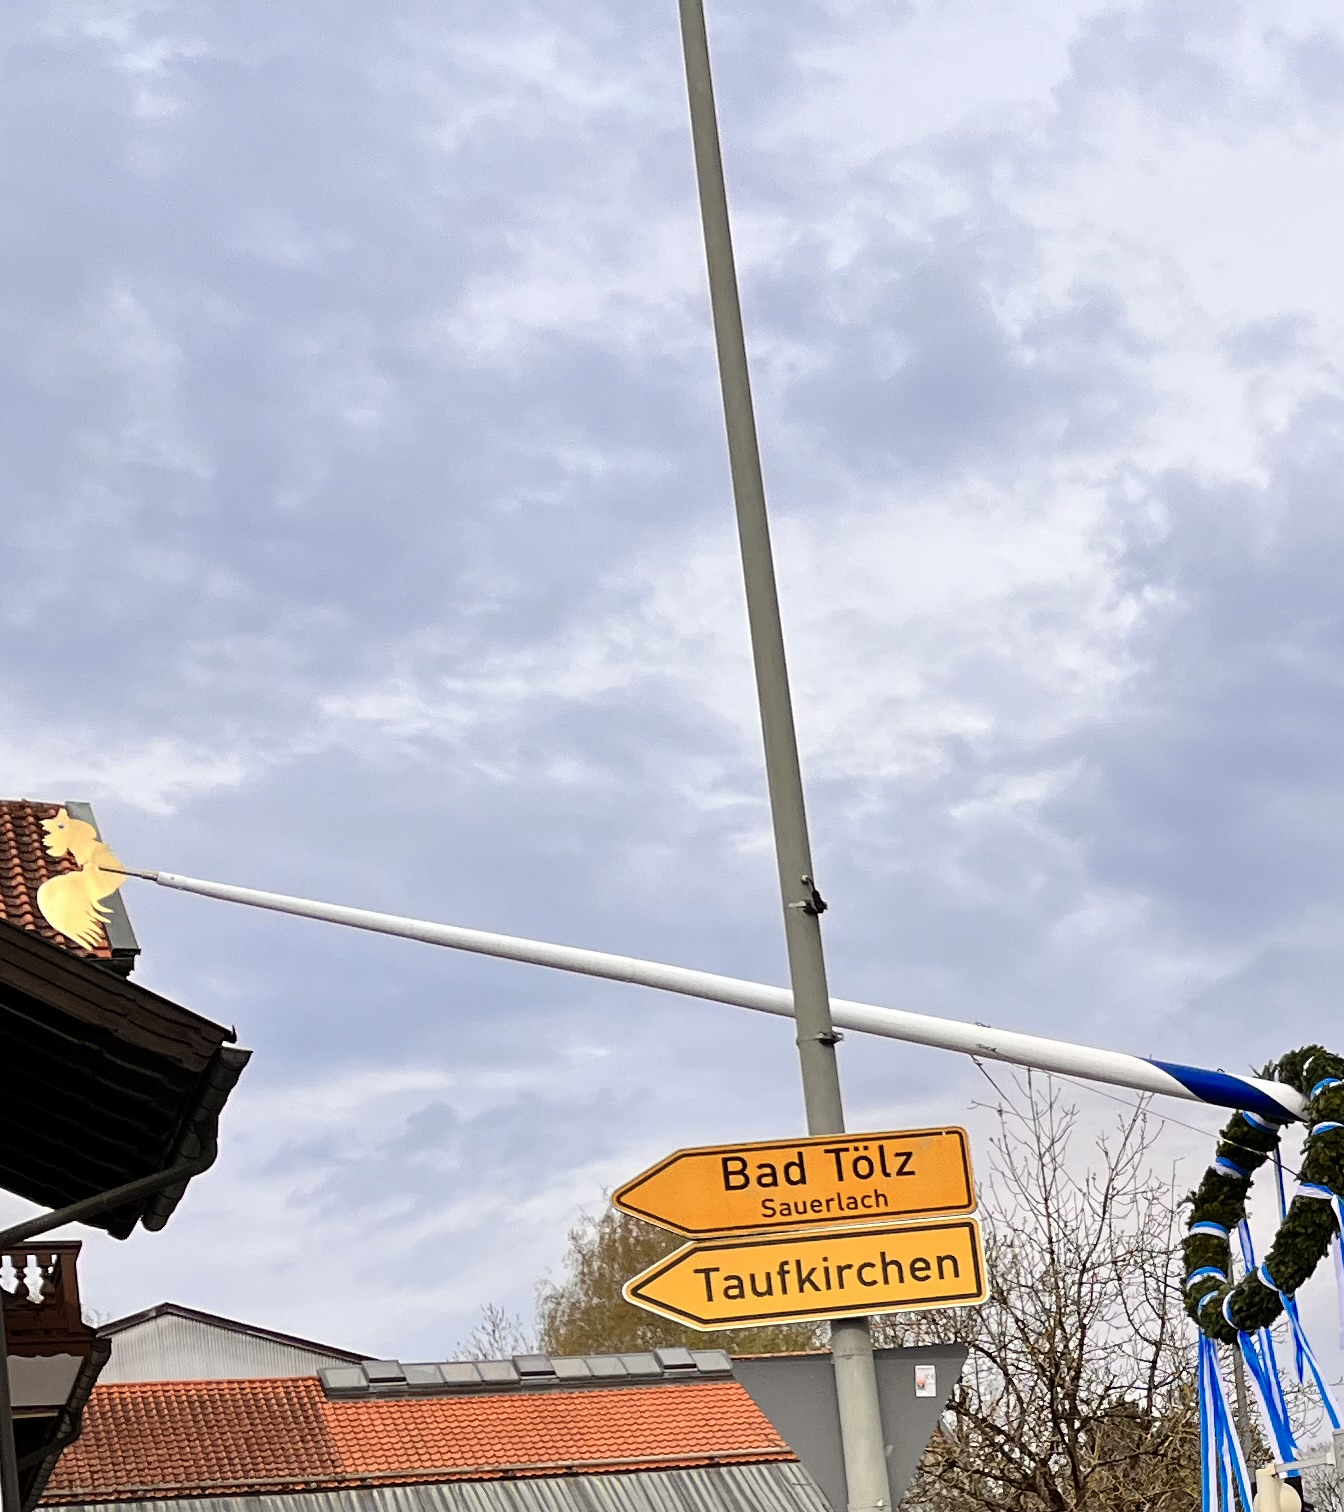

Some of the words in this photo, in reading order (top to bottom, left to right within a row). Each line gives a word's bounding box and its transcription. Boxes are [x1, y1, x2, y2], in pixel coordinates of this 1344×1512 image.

[721, 1152, 807, 1192] Bad
[823, 1145, 916, 1183] Tölz
[761, 1192, 889, 1218] Sauerlach
[694, 1252, 961, 1303] Taufkirchen
